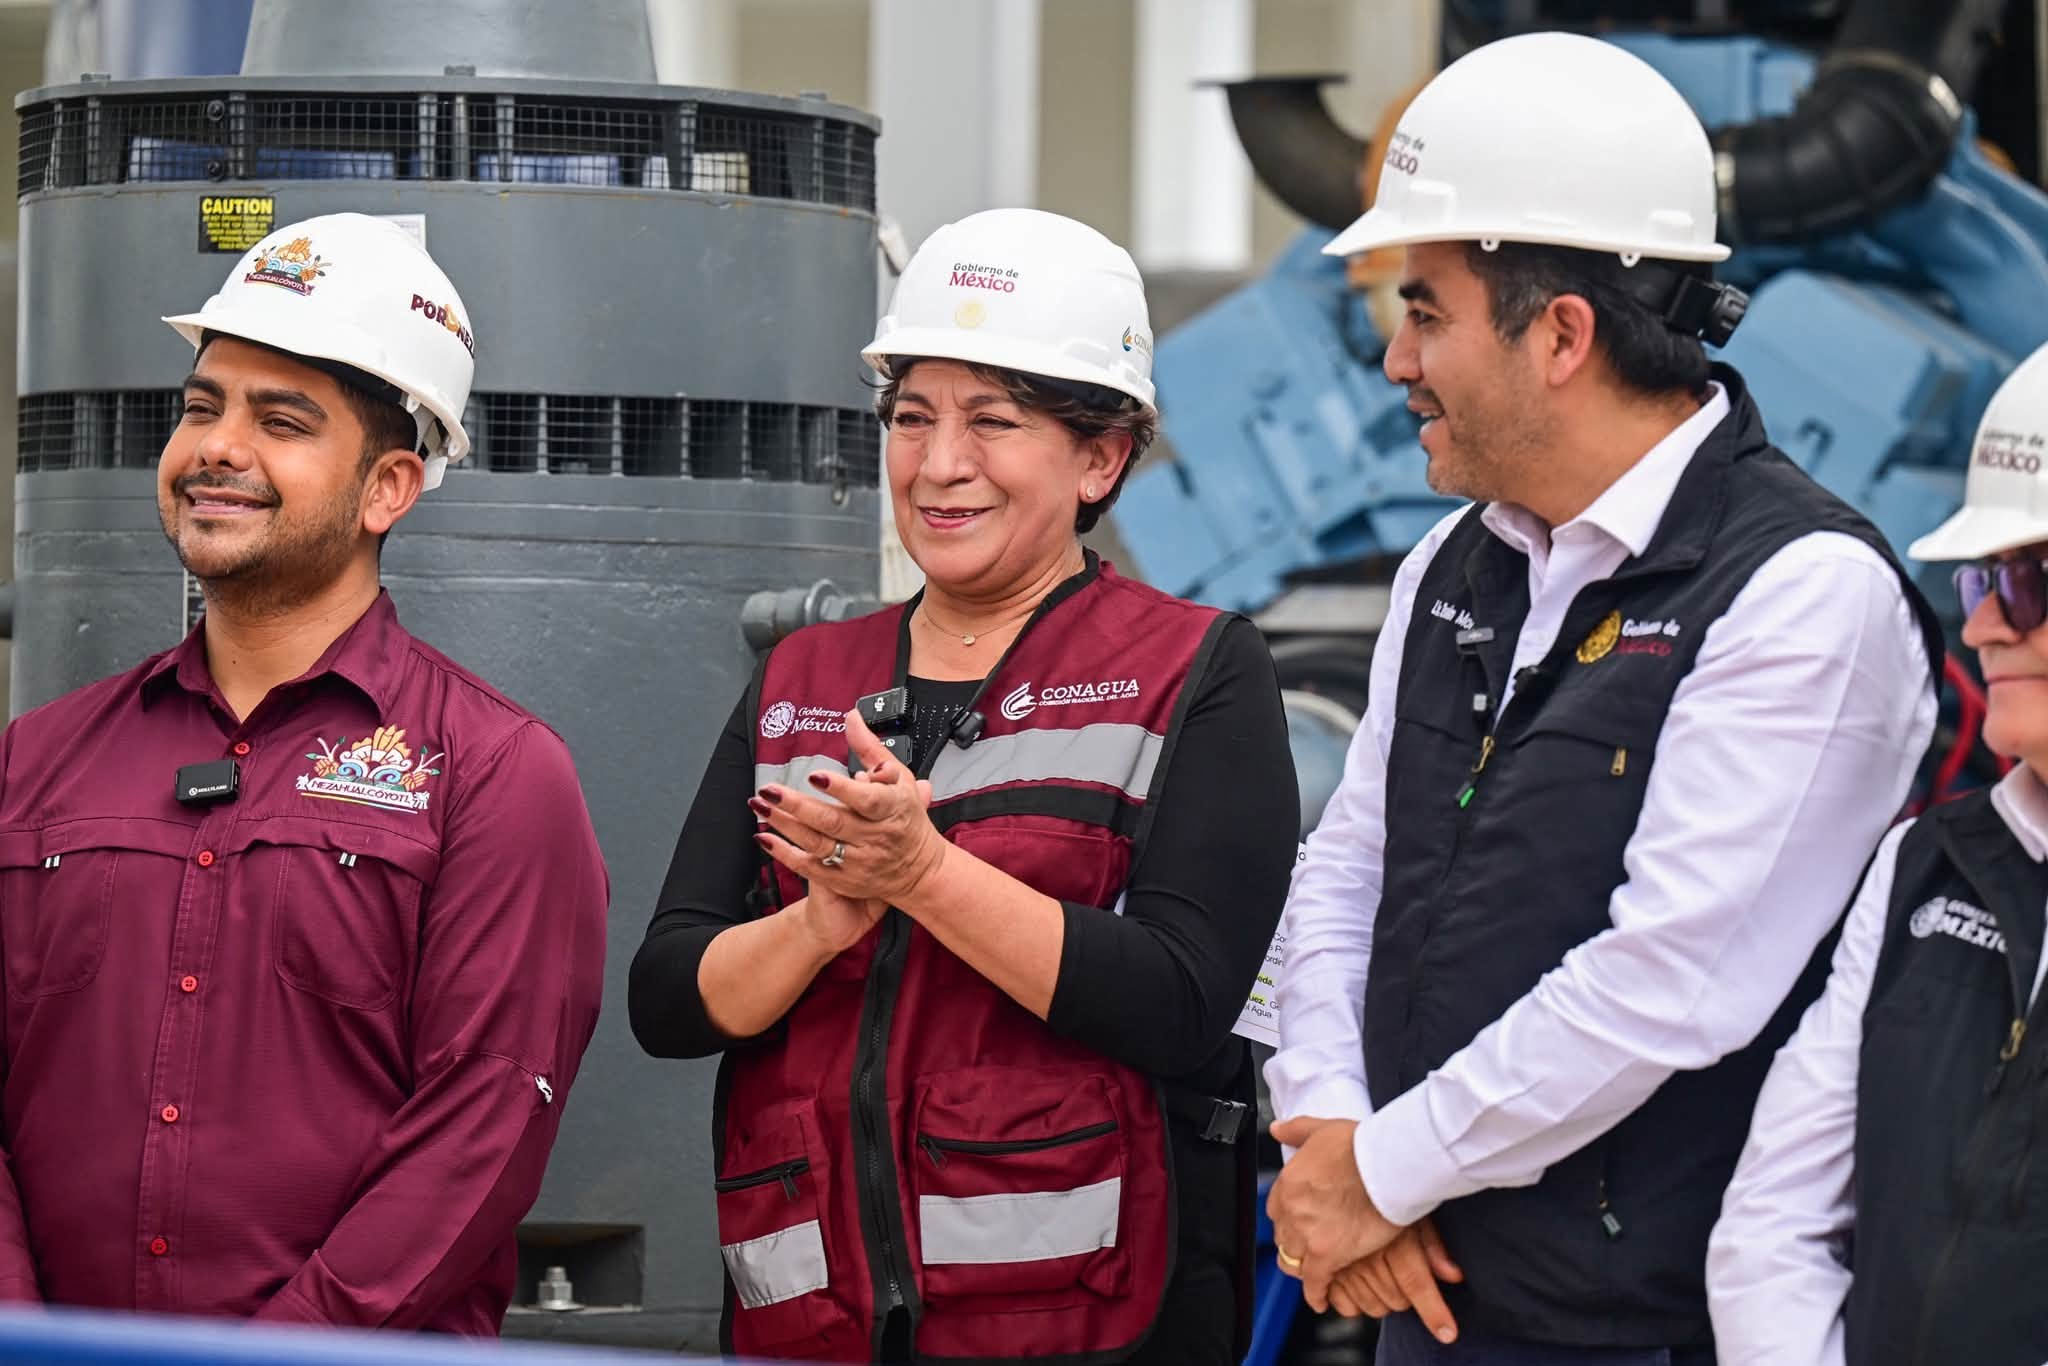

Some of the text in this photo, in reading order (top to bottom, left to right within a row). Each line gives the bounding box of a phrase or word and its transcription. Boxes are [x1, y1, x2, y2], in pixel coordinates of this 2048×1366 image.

[202, 198, 273, 214] CAUTION
[953, 262, 1019, 278] Gobierno de
[949, 271, 1015, 293] México
[410, 293, 448, 327] POR
[1040, 679, 1140, 700] CONAGUA
[798, 706, 842, 717] Gobierno
[790, 717, 846, 734] México
